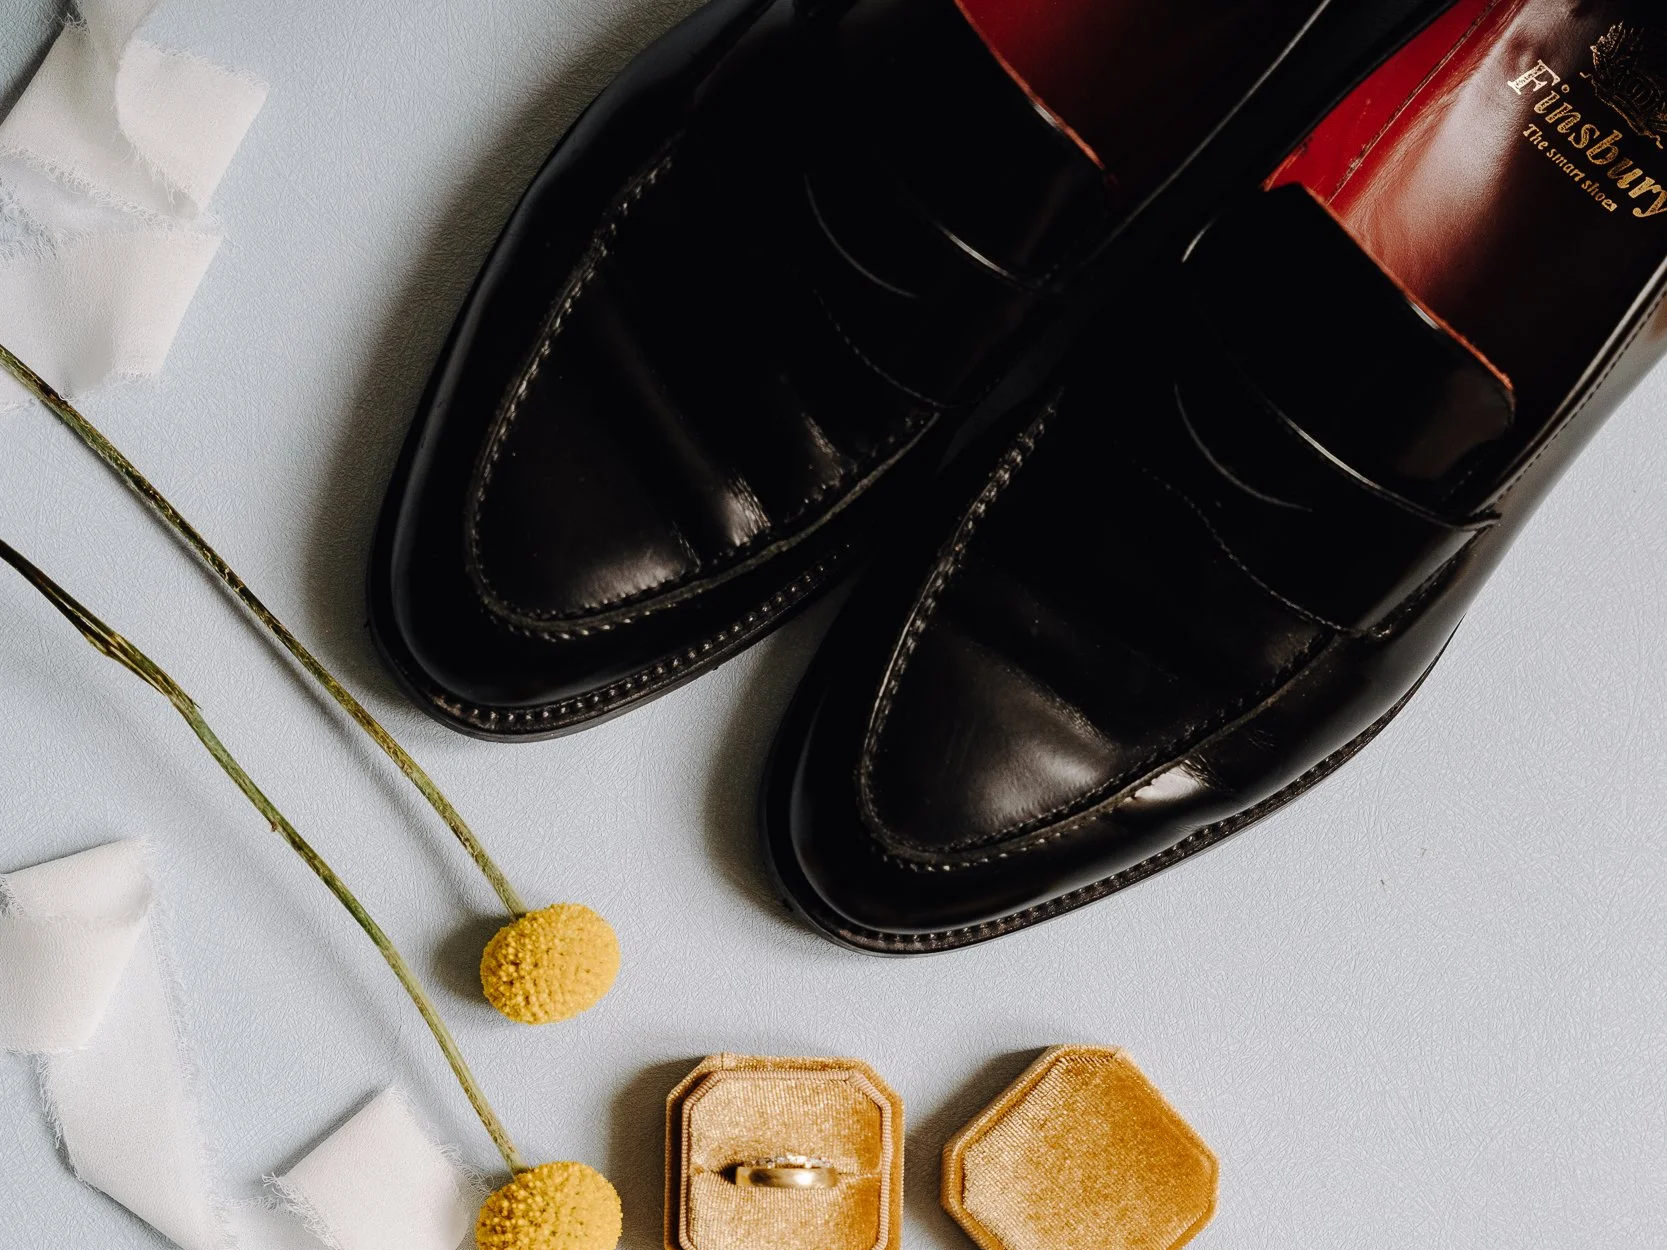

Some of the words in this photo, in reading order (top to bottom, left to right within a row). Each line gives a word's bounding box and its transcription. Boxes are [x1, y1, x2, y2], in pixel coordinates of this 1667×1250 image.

[1507, 59, 1667, 218] Finsbury
[1522, 123, 1549, 151] The
[1546, 148, 1586, 182] smart
[1581, 178, 1618, 212] shoes
